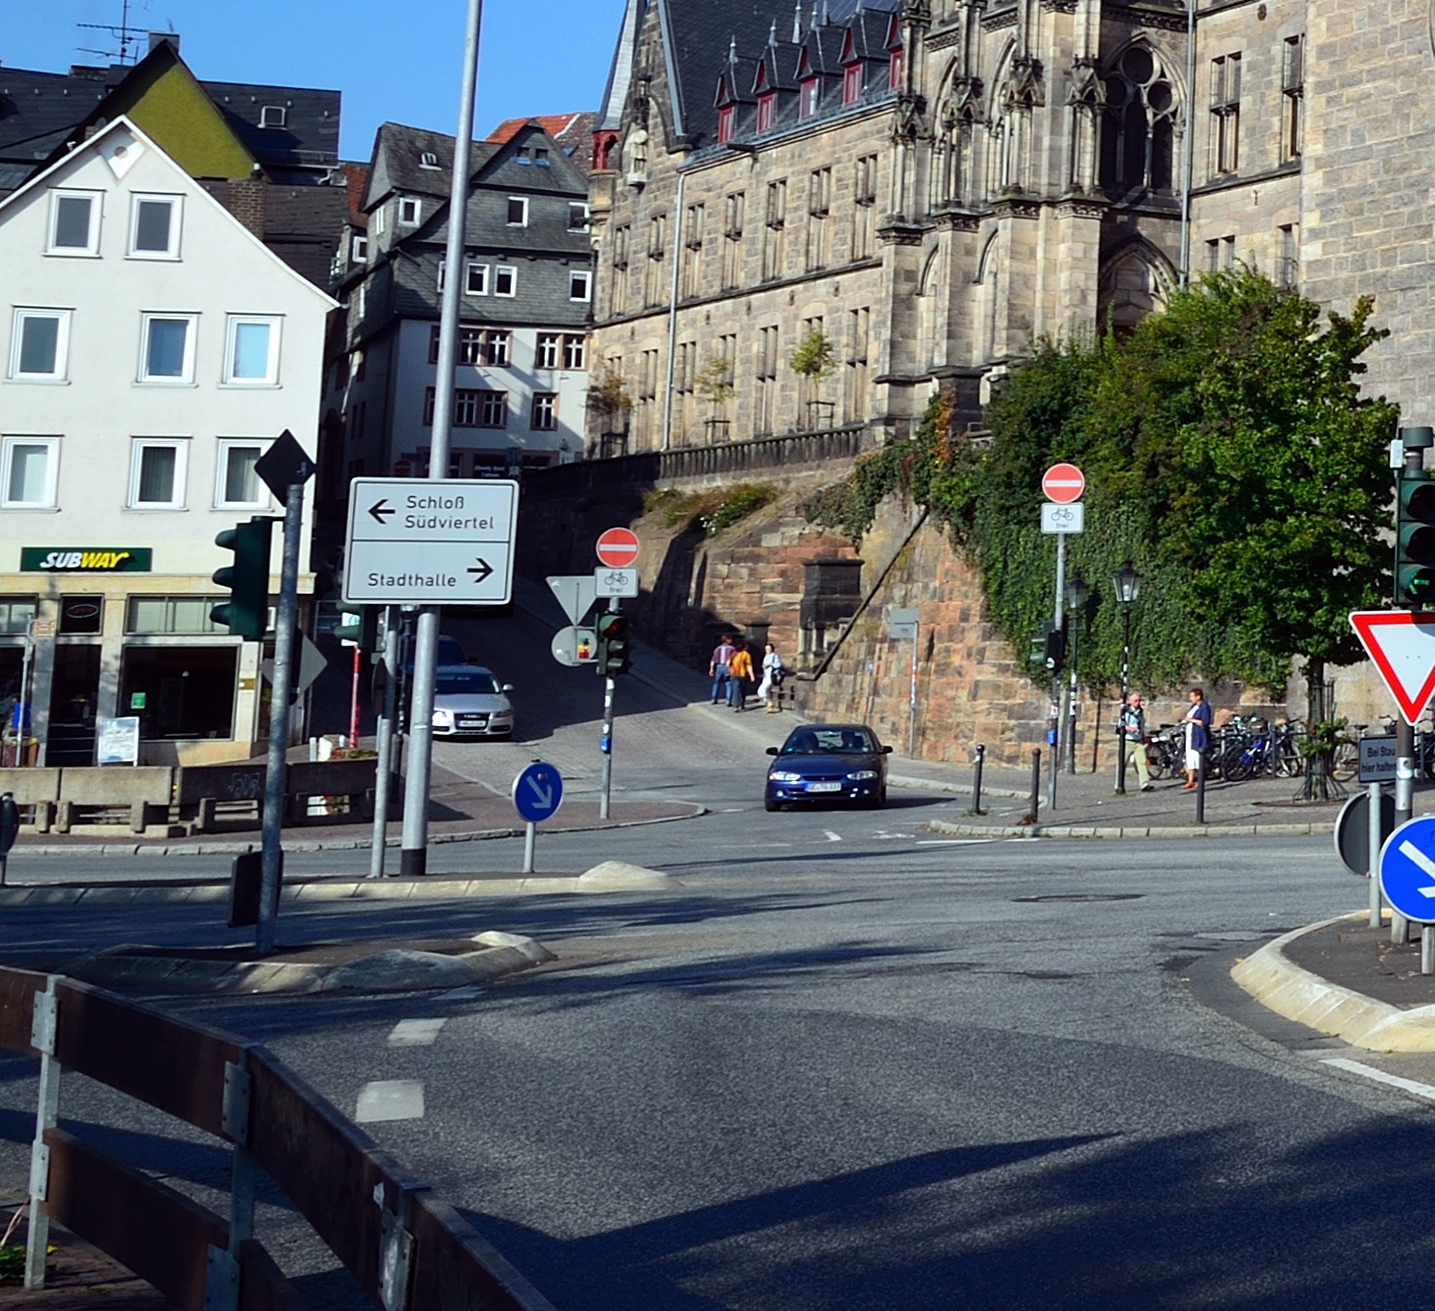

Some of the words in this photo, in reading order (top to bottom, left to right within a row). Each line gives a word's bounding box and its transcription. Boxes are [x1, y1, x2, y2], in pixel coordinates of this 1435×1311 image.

[406, 495, 465, 509] Schloß
[404, 515, 494, 529] Südviertel
[39, 552, 130, 568] SUBWAY
[368, 573, 457, 587] Stadthalle
[1367, 746, 1379, 758] Bei
[1380, 745, 1396, 757] Stau
[1361, 762, 1375, 773] hier
